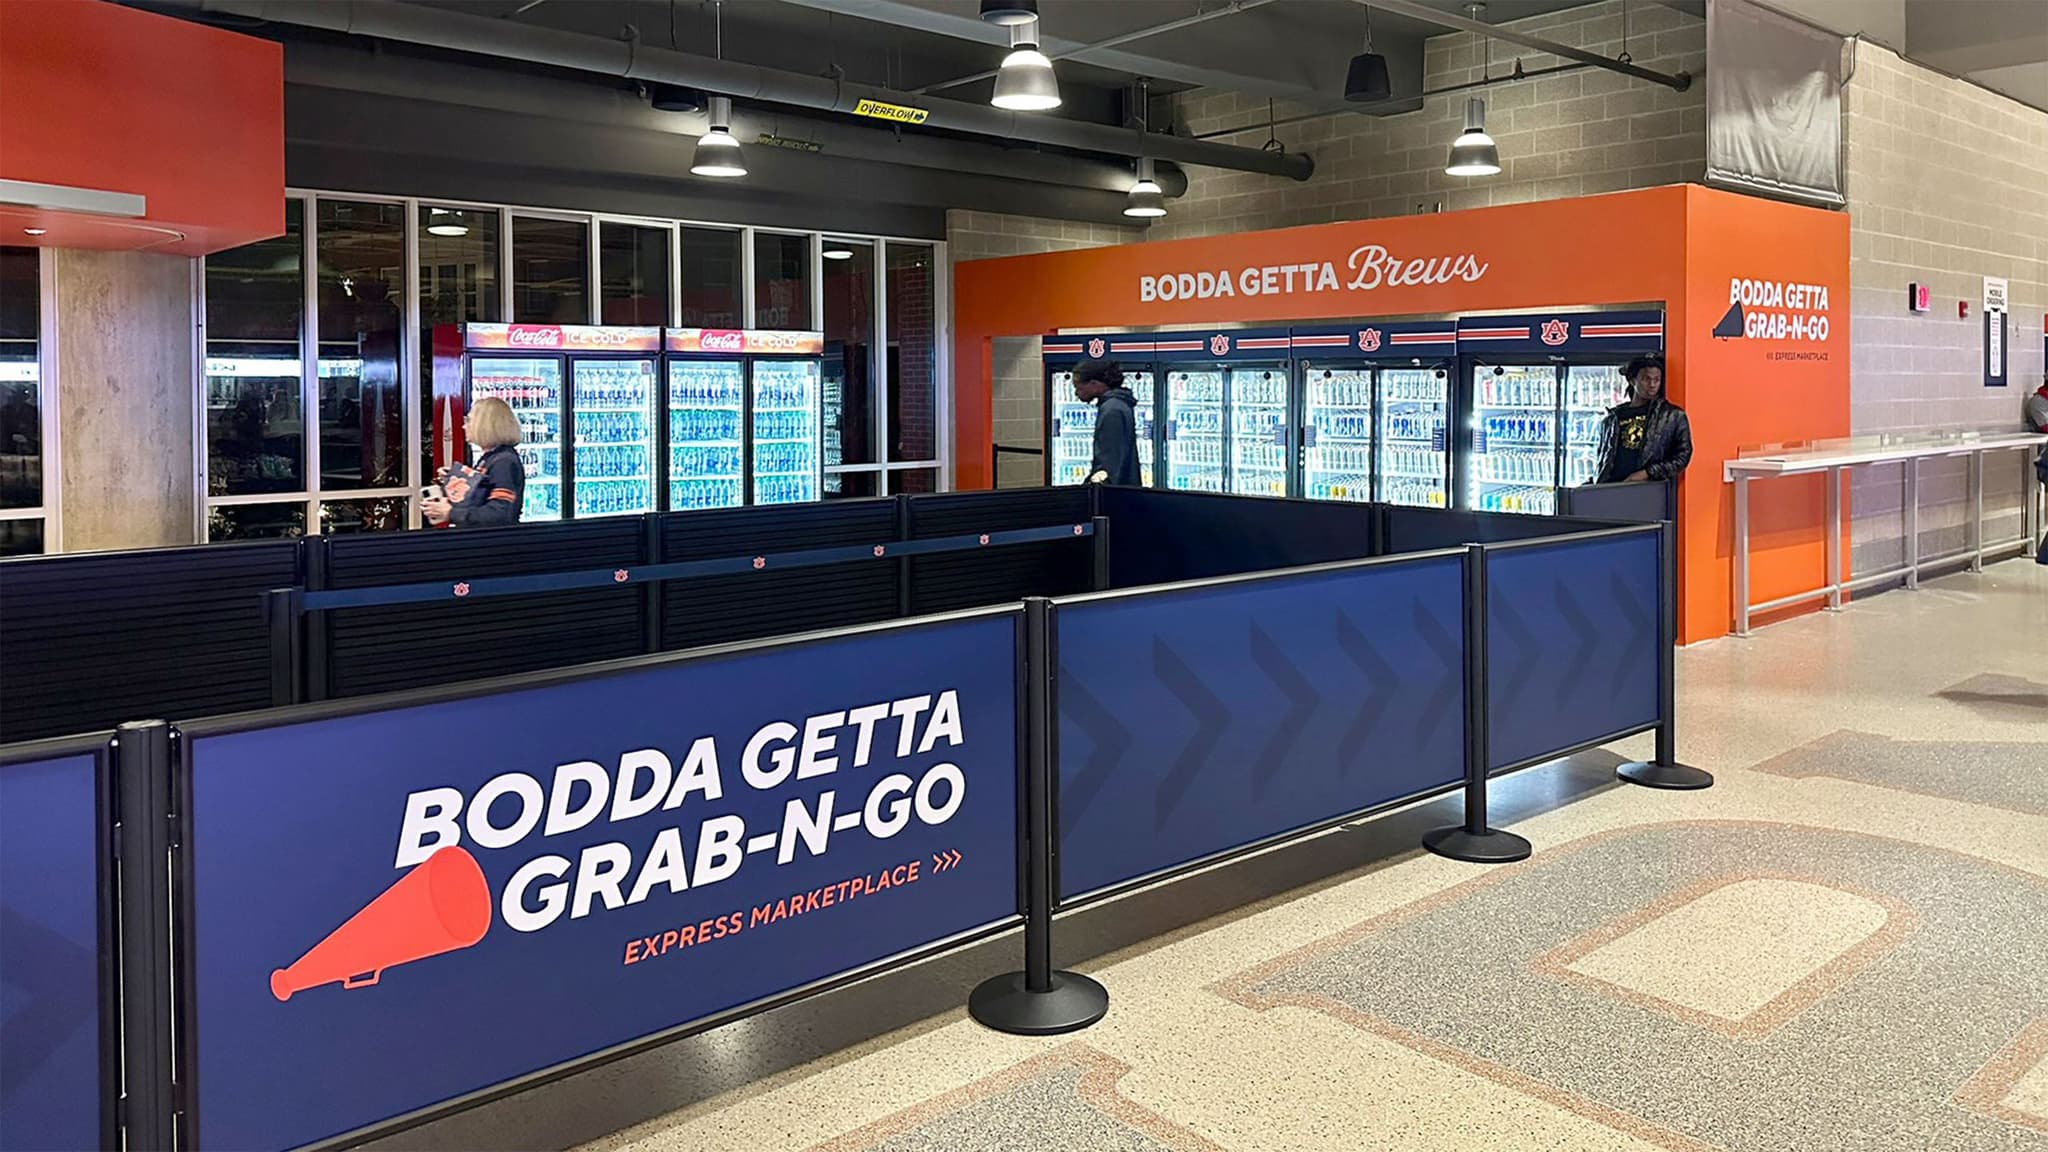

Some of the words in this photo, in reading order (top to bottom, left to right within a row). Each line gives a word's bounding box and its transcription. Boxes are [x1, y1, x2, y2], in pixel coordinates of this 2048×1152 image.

[860, 103, 913, 121] OVERFLOW
[1140, 270, 1235, 302] BODDA
[1239, 262, 1339, 296] GETTA
[1347, 244, 1488, 290] Brews
[1729, 278, 1783, 308] BODDA
[1785, 283, 1829, 311] GETTA
[565, 332, 587, 344] ICE
[592, 333, 627, 344] COLD
[747, 335, 766, 347] ICE
[768, 336, 798, 348] COLD
[1745, 311, 1829, 341] GRAB-N-GO
[394, 736, 723, 869] BODDA
[741, 690, 964, 790] GETTA
[501, 762, 966, 932] GRAB-N-GO
[623, 911, 743, 966] EXPRESS
[750, 860, 921, 929] MARKETPLACE
